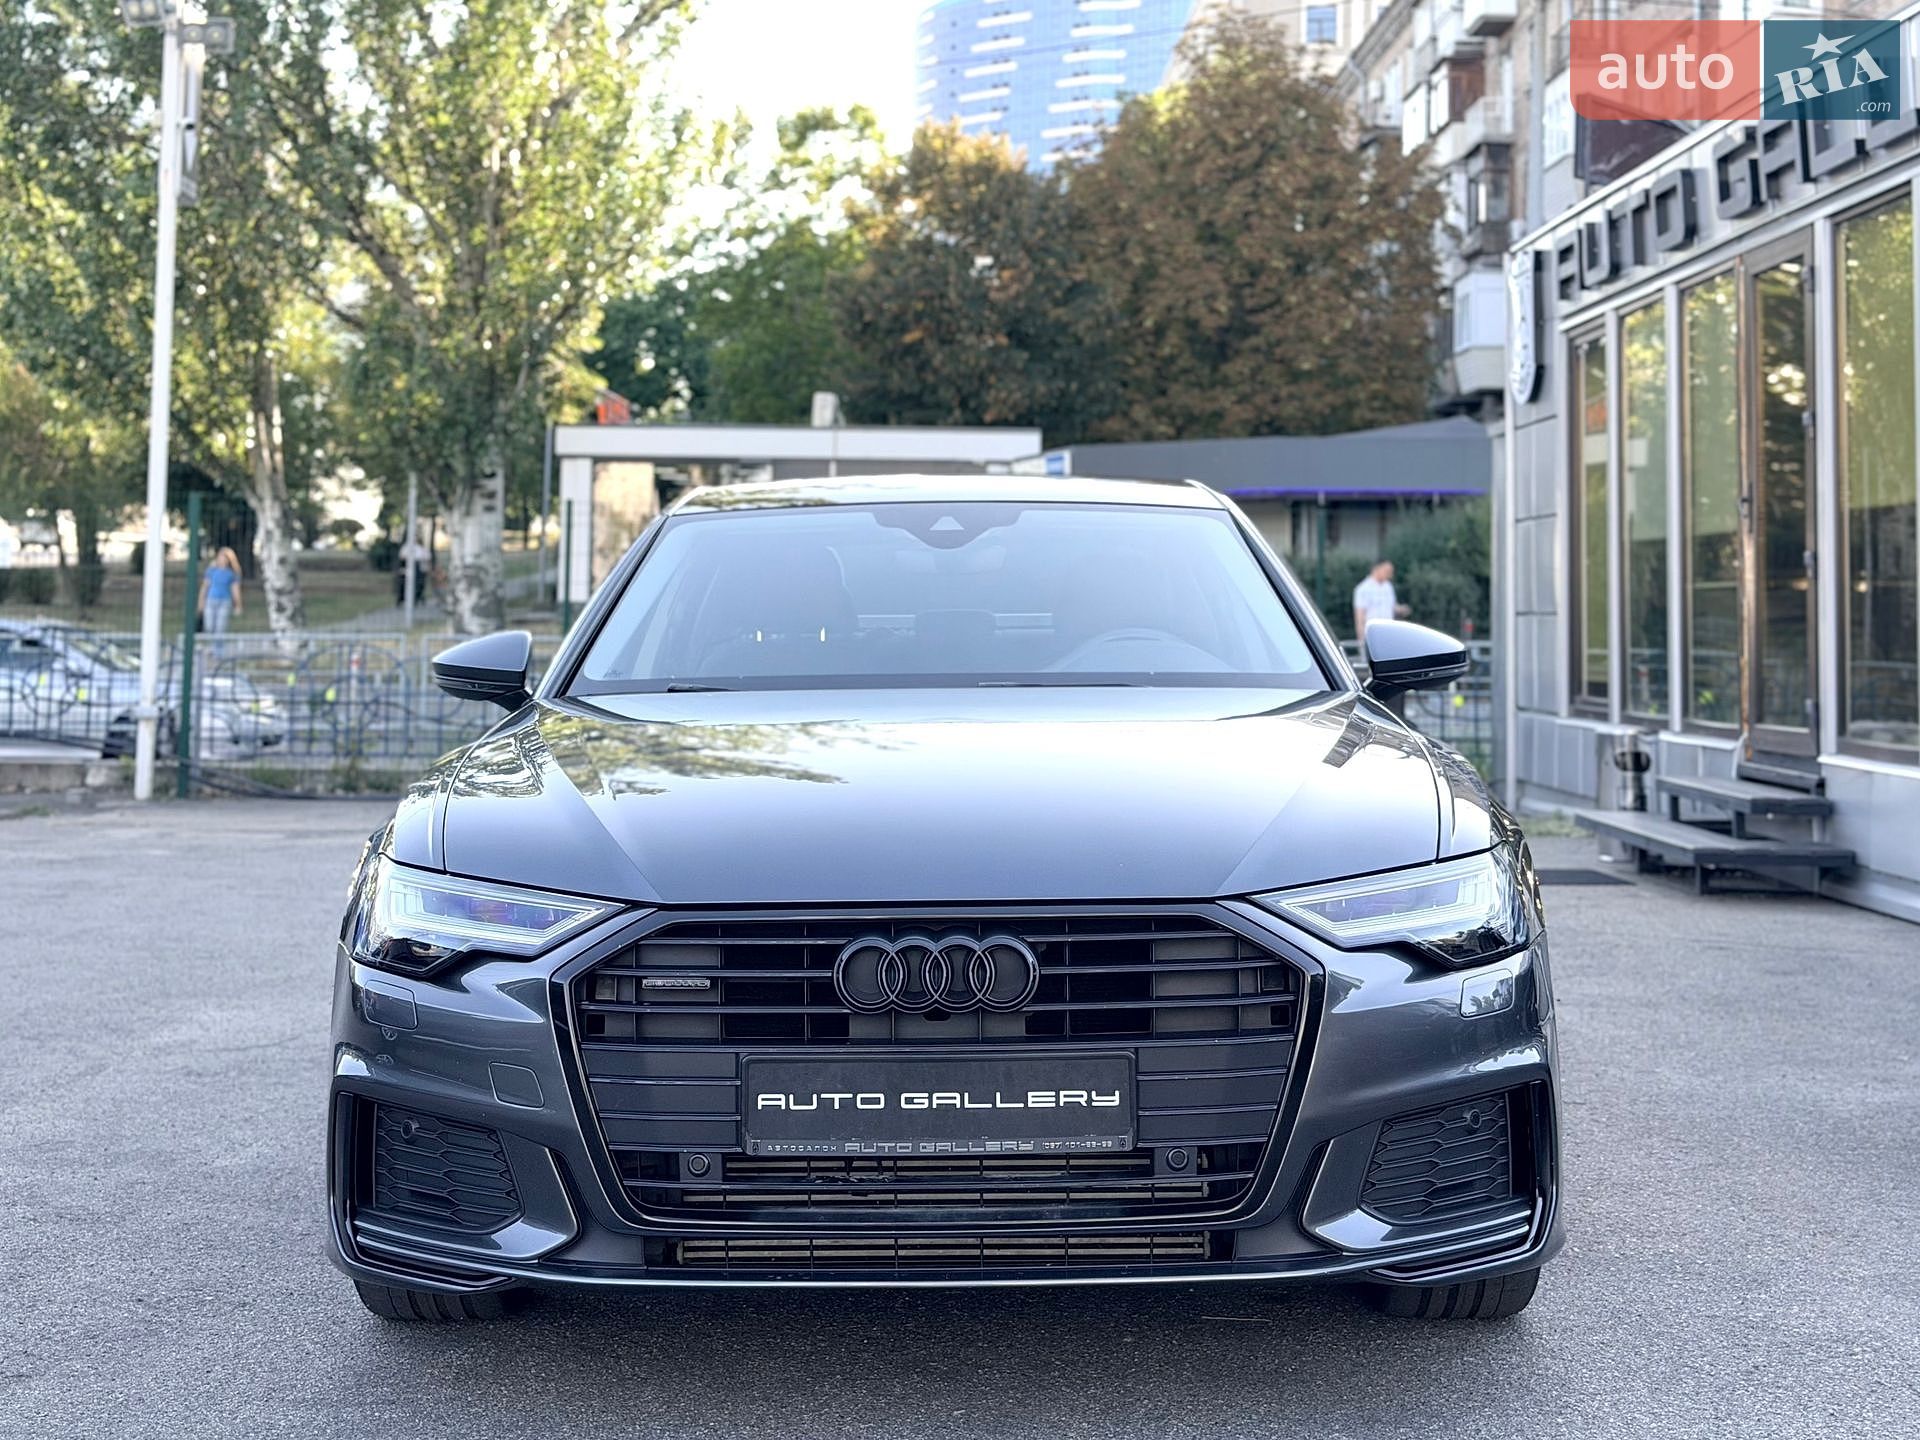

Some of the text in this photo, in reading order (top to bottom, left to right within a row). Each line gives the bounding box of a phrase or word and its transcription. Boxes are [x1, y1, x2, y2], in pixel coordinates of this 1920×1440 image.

[1553, 168, 1696, 301] AUTO
[757, 1090, 1120, 1111] AUTO GALLERY
[844, 1142, 913, 1153] AUTO
[919, 1141, 1035, 1152] GALLERY
